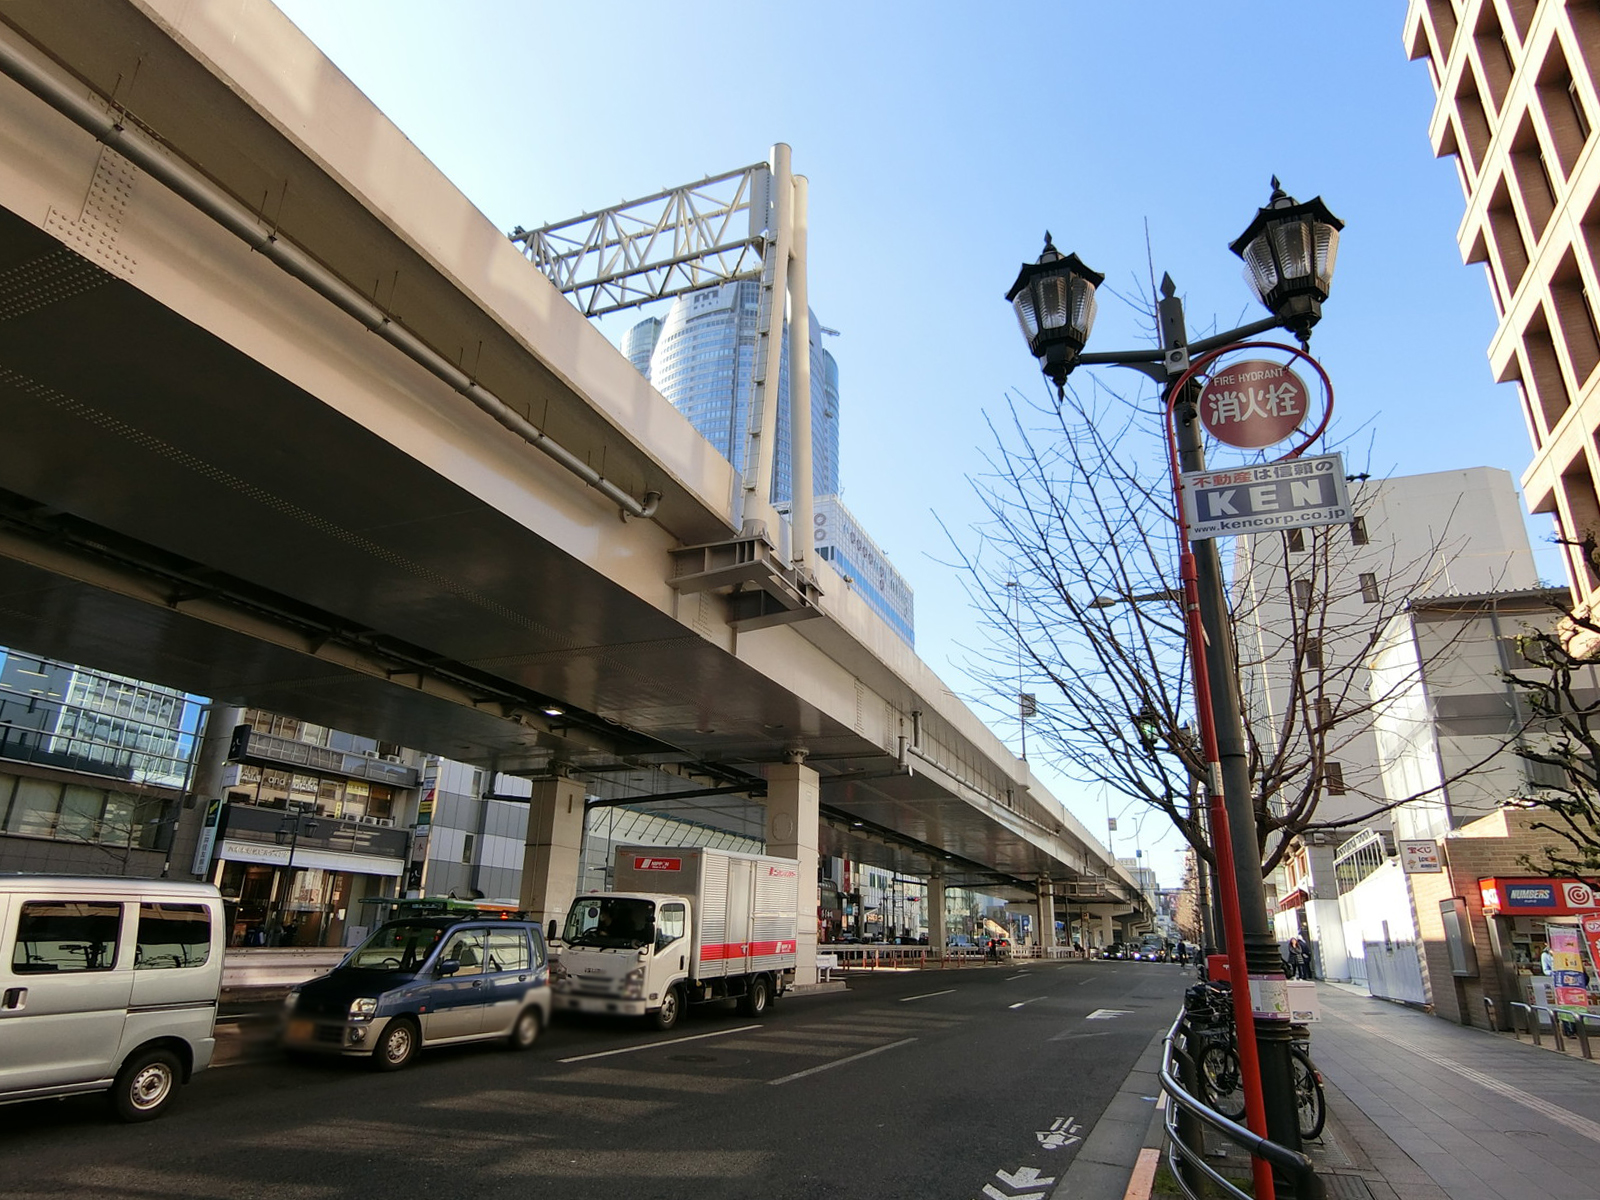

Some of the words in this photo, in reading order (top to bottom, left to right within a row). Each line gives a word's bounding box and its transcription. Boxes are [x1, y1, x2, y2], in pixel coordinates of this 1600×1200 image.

[1214, 375, 1235, 386] FIRE
[1238, 368, 1283, 383] HYDRANT
[1208, 382, 1299, 425] 消火栓
[1192, 461, 1334, 488] 不動産は信頼の
[1207, 479, 1322, 517] KEN
[1194, 508, 1346, 533] www.kencorp.co.jp
[1510, 889, 1551, 899] NUMBERS
